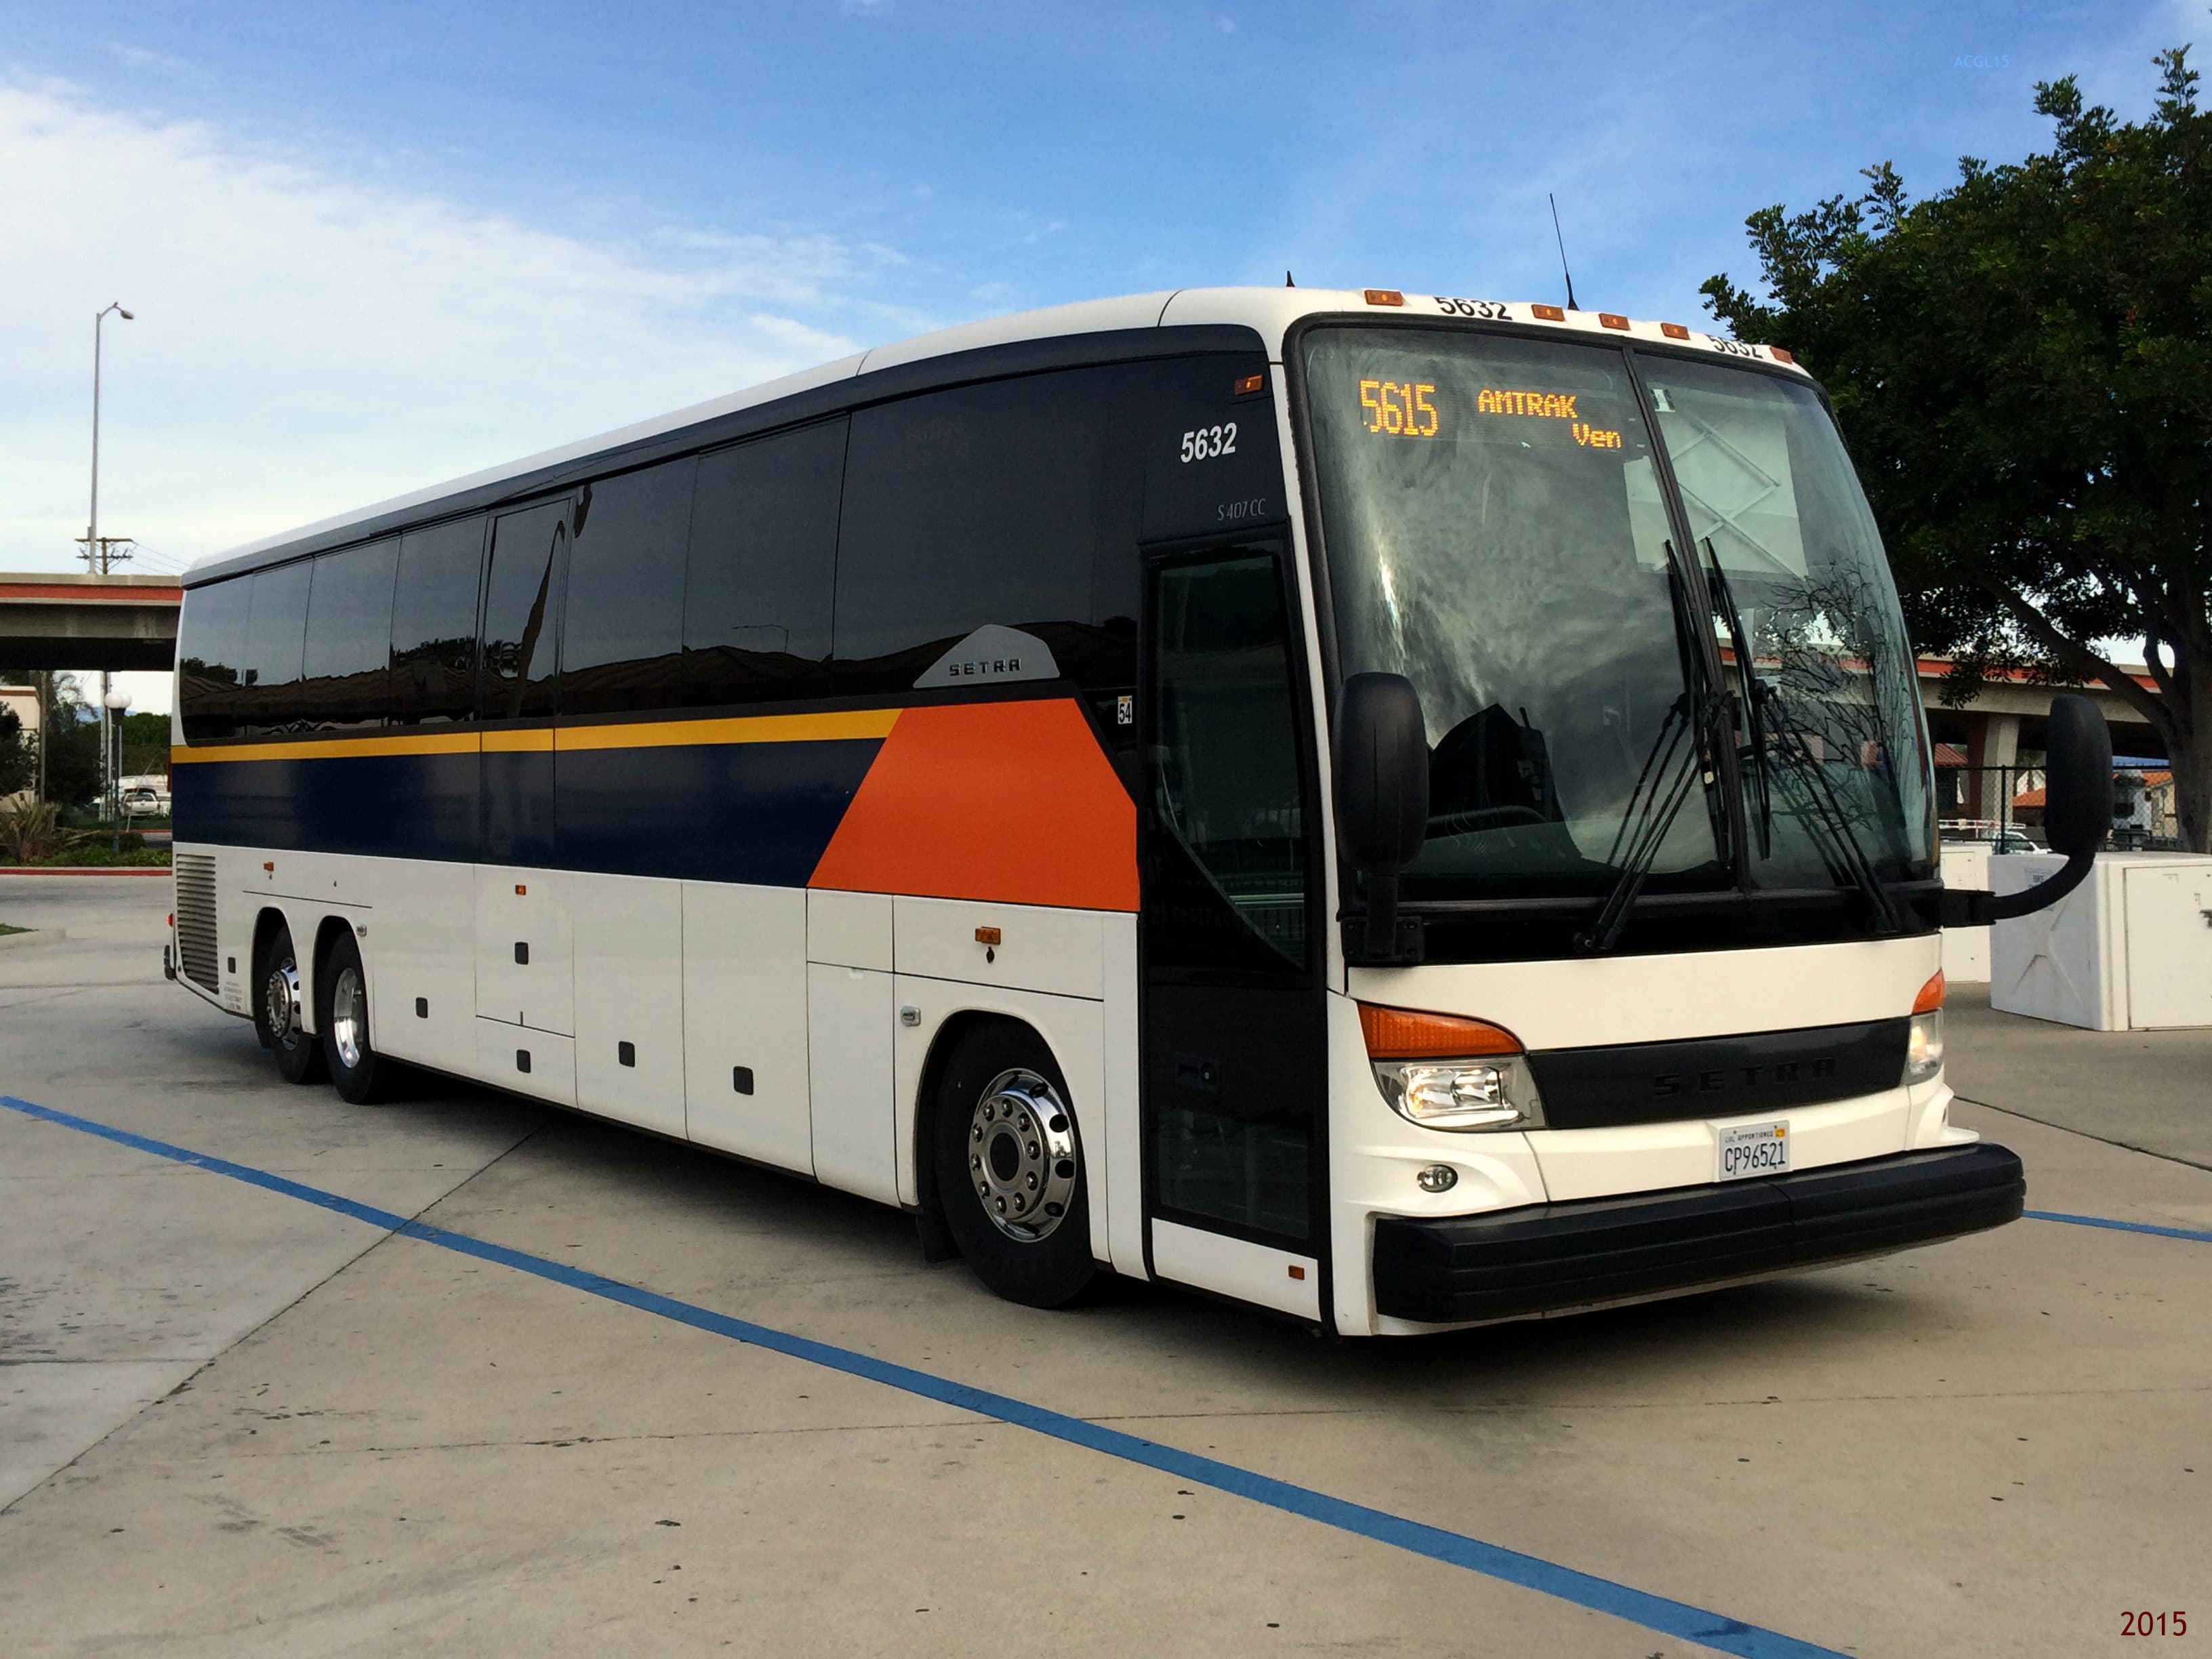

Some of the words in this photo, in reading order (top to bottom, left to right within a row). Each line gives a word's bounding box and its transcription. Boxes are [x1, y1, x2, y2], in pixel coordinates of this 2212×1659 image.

[1433, 296, 1513, 321] 5632
[1360, 380, 1438, 437] 5615
[1478, 389, 1578, 418] AMTRAK
[1181, 422, 1237, 463] 5632
[1572, 423, 1621, 449] Ven
[1217, 504, 1225, 520] S
[1227, 501, 1248, 519] 407
[1250, 498, 1266, 516] CC
[949, 658, 1022, 676] SETRA
[1119, 703, 1131, 723] 54
[1654, 1058, 1835, 1096] SETRA
[1725, 1141, 1786, 1172] CP96521
